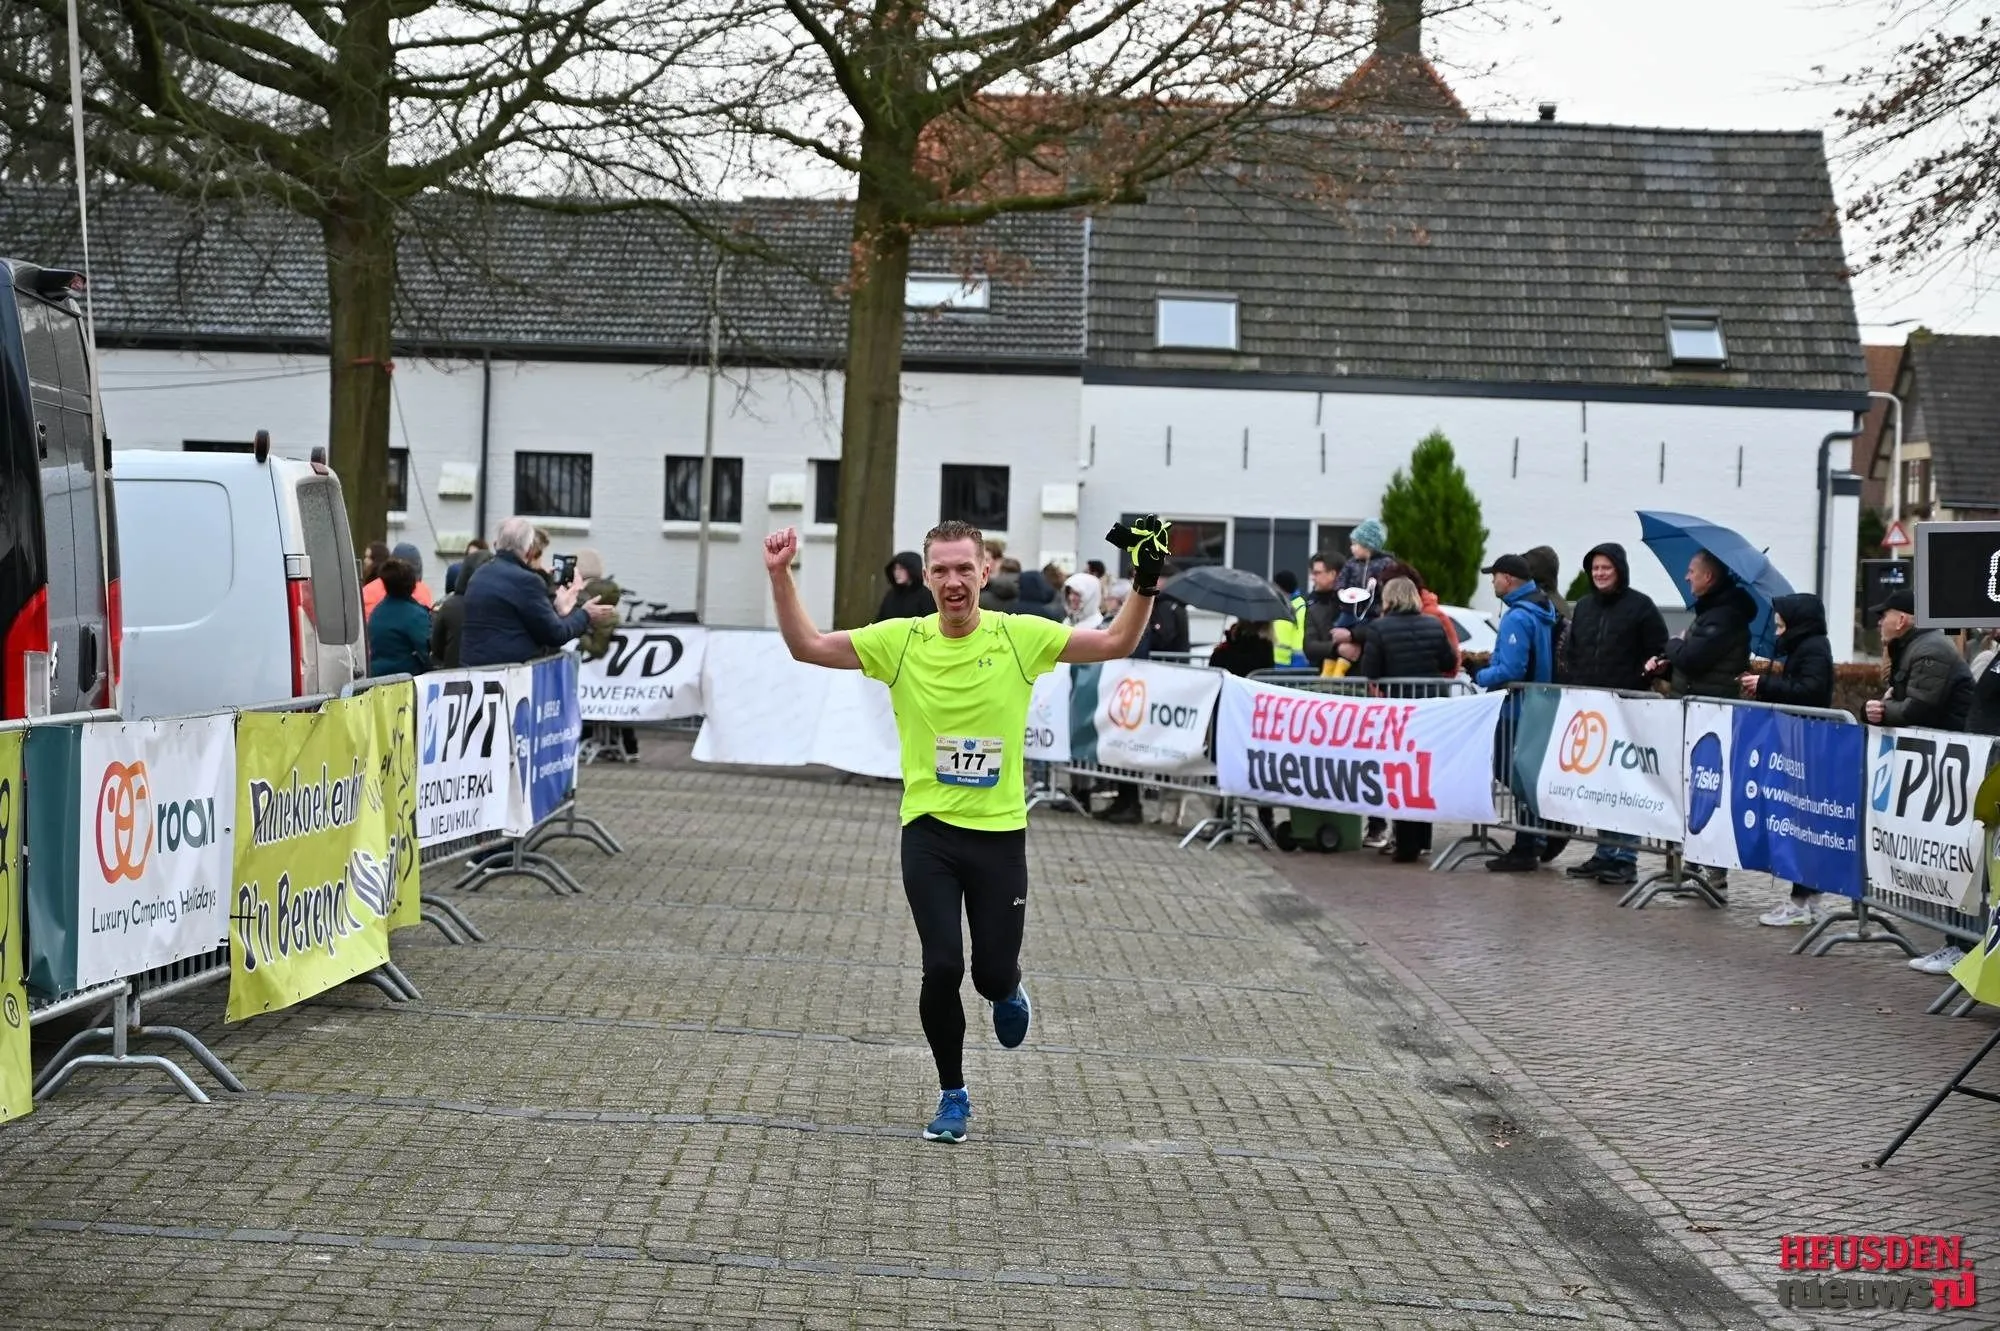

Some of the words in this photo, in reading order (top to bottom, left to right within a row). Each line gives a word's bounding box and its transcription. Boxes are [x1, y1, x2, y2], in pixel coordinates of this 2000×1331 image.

[1150, 702, 1198, 731] roan
[950, 752, 987, 771] 177
[1608, 738, 1661, 777] roan
[1548, 781, 1576, 800] Luxury
[1576, 784, 1618, 807] Camping
[1619, 791, 1665, 813] Holidays
[1694, 765, 1721, 791] Fiske
[1895, 736, 1971, 827] PVD
[157, 797, 216, 854] roan
[1872, 827, 1974, 873] GRONDWERKEN
[92, 907, 130, 933] Luxury
[131, 896, 177, 927] Camping
[180, 885, 216, 915] Holidays
